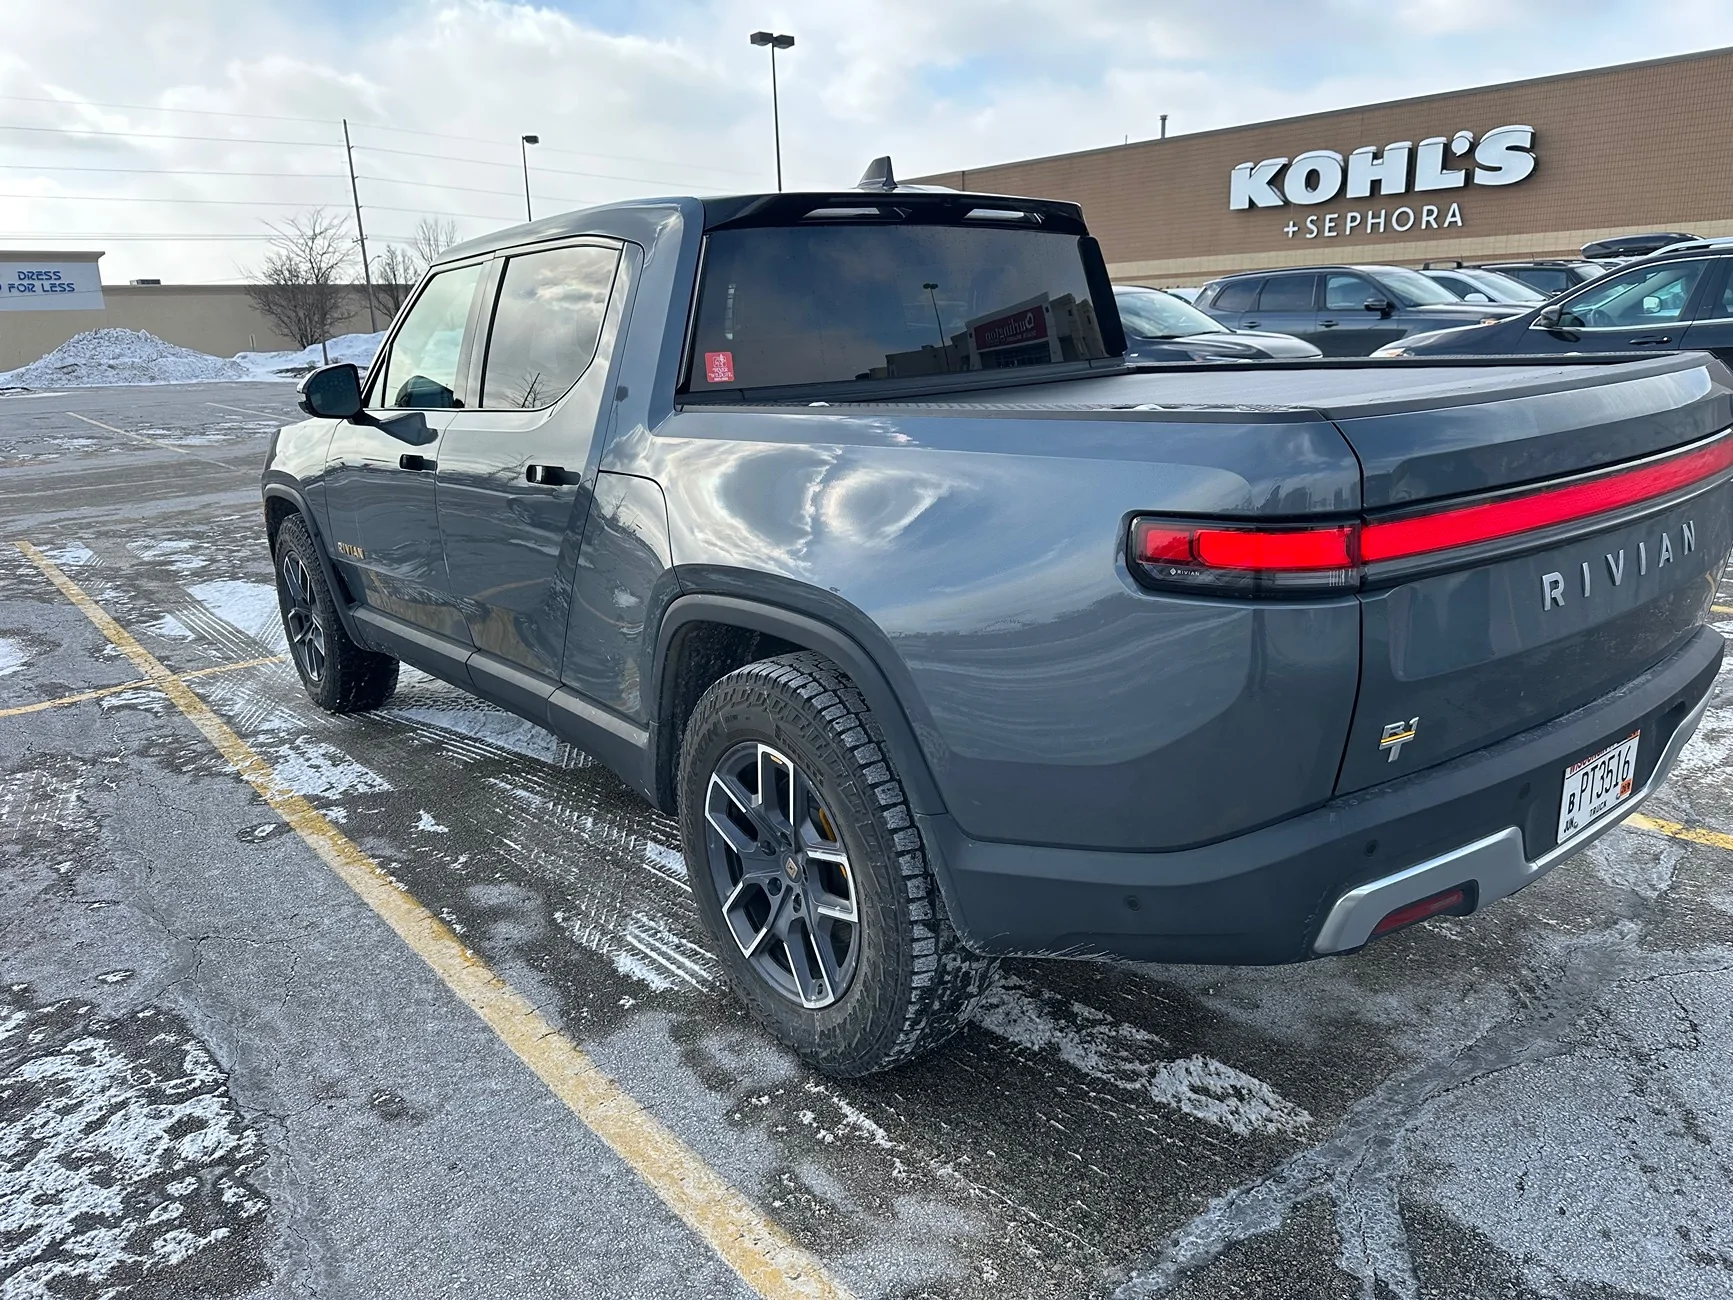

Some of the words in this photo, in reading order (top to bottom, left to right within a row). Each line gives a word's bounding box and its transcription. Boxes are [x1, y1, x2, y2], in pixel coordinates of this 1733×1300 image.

[1229, 124, 1537, 211] KOHL'S
[17, 270, 62, 281] DRESS
[8, 283, 36, 293] FOR
[41, 282, 76, 293] LESS
[337, 541, 365, 560] RIVIAN
[1541, 520, 1696, 612] RIVIAN
[1567, 792, 1576, 815] B
[1578, 745, 1631, 812] PT3516
[1589, 799, 1608, 818] TRUCK
